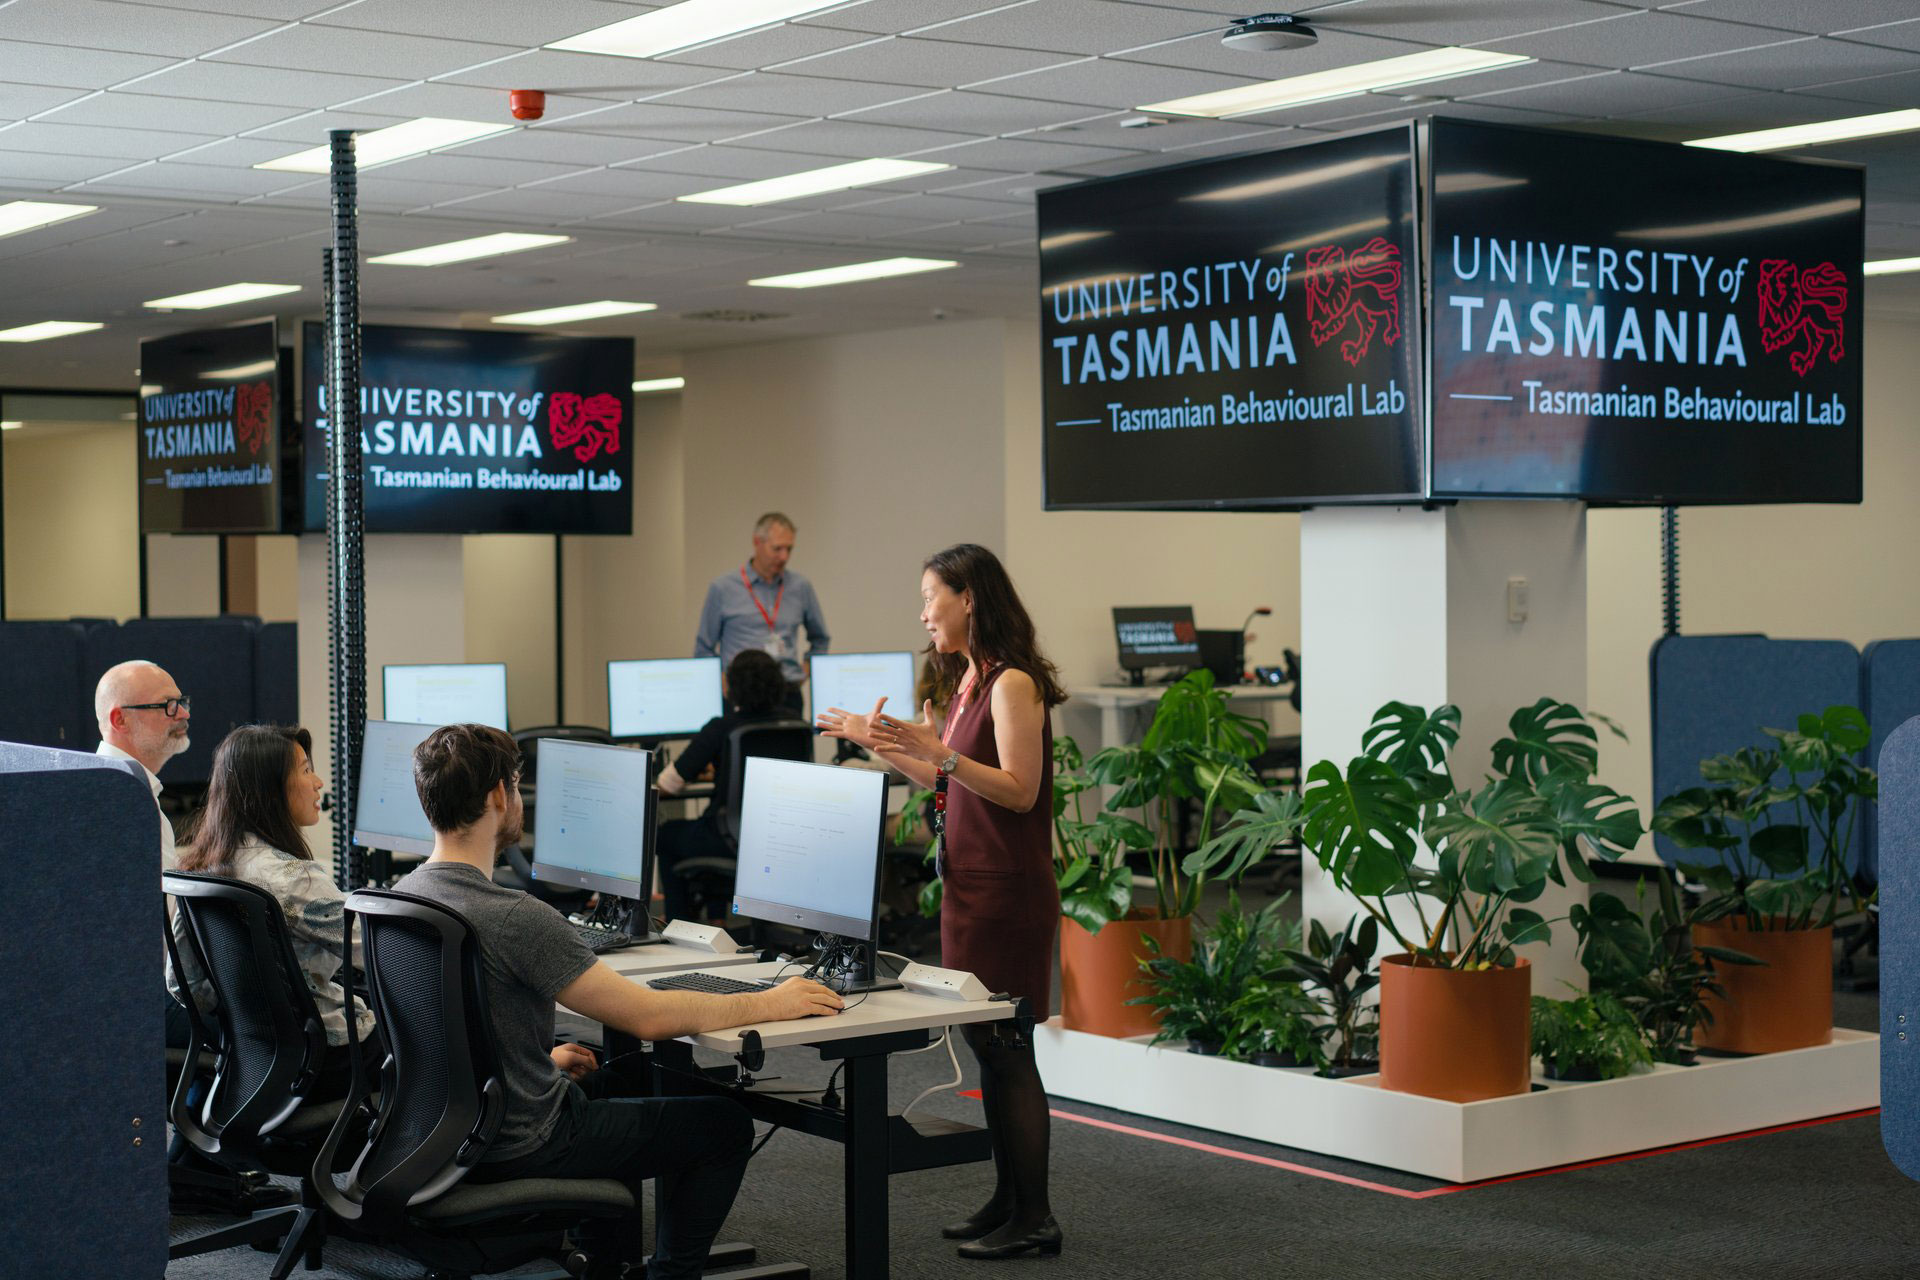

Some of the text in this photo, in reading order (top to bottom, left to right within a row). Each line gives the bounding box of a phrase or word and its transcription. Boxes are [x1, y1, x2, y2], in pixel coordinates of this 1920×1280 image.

[1054, 252, 1295, 324] UNIVERSITY of
[1453, 235, 1749, 303] UNIVERSITY of
[1053, 312, 1297, 385] TASMANIA
[1449, 295, 1747, 367] TASMANIA
[145, 385, 236, 422] UNIVERSITY of
[518, 392, 543, 421] of
[1107, 379, 1405, 432] Tasmanian Behavioural Lab
[1522, 380, 1846, 426] Tasmanian Behavioural Lab
[144, 420, 236, 459] TASMANIA
[257, 462, 272, 485] Lab
[369, 465, 622, 491] Tasmanian Behavioural Lab
